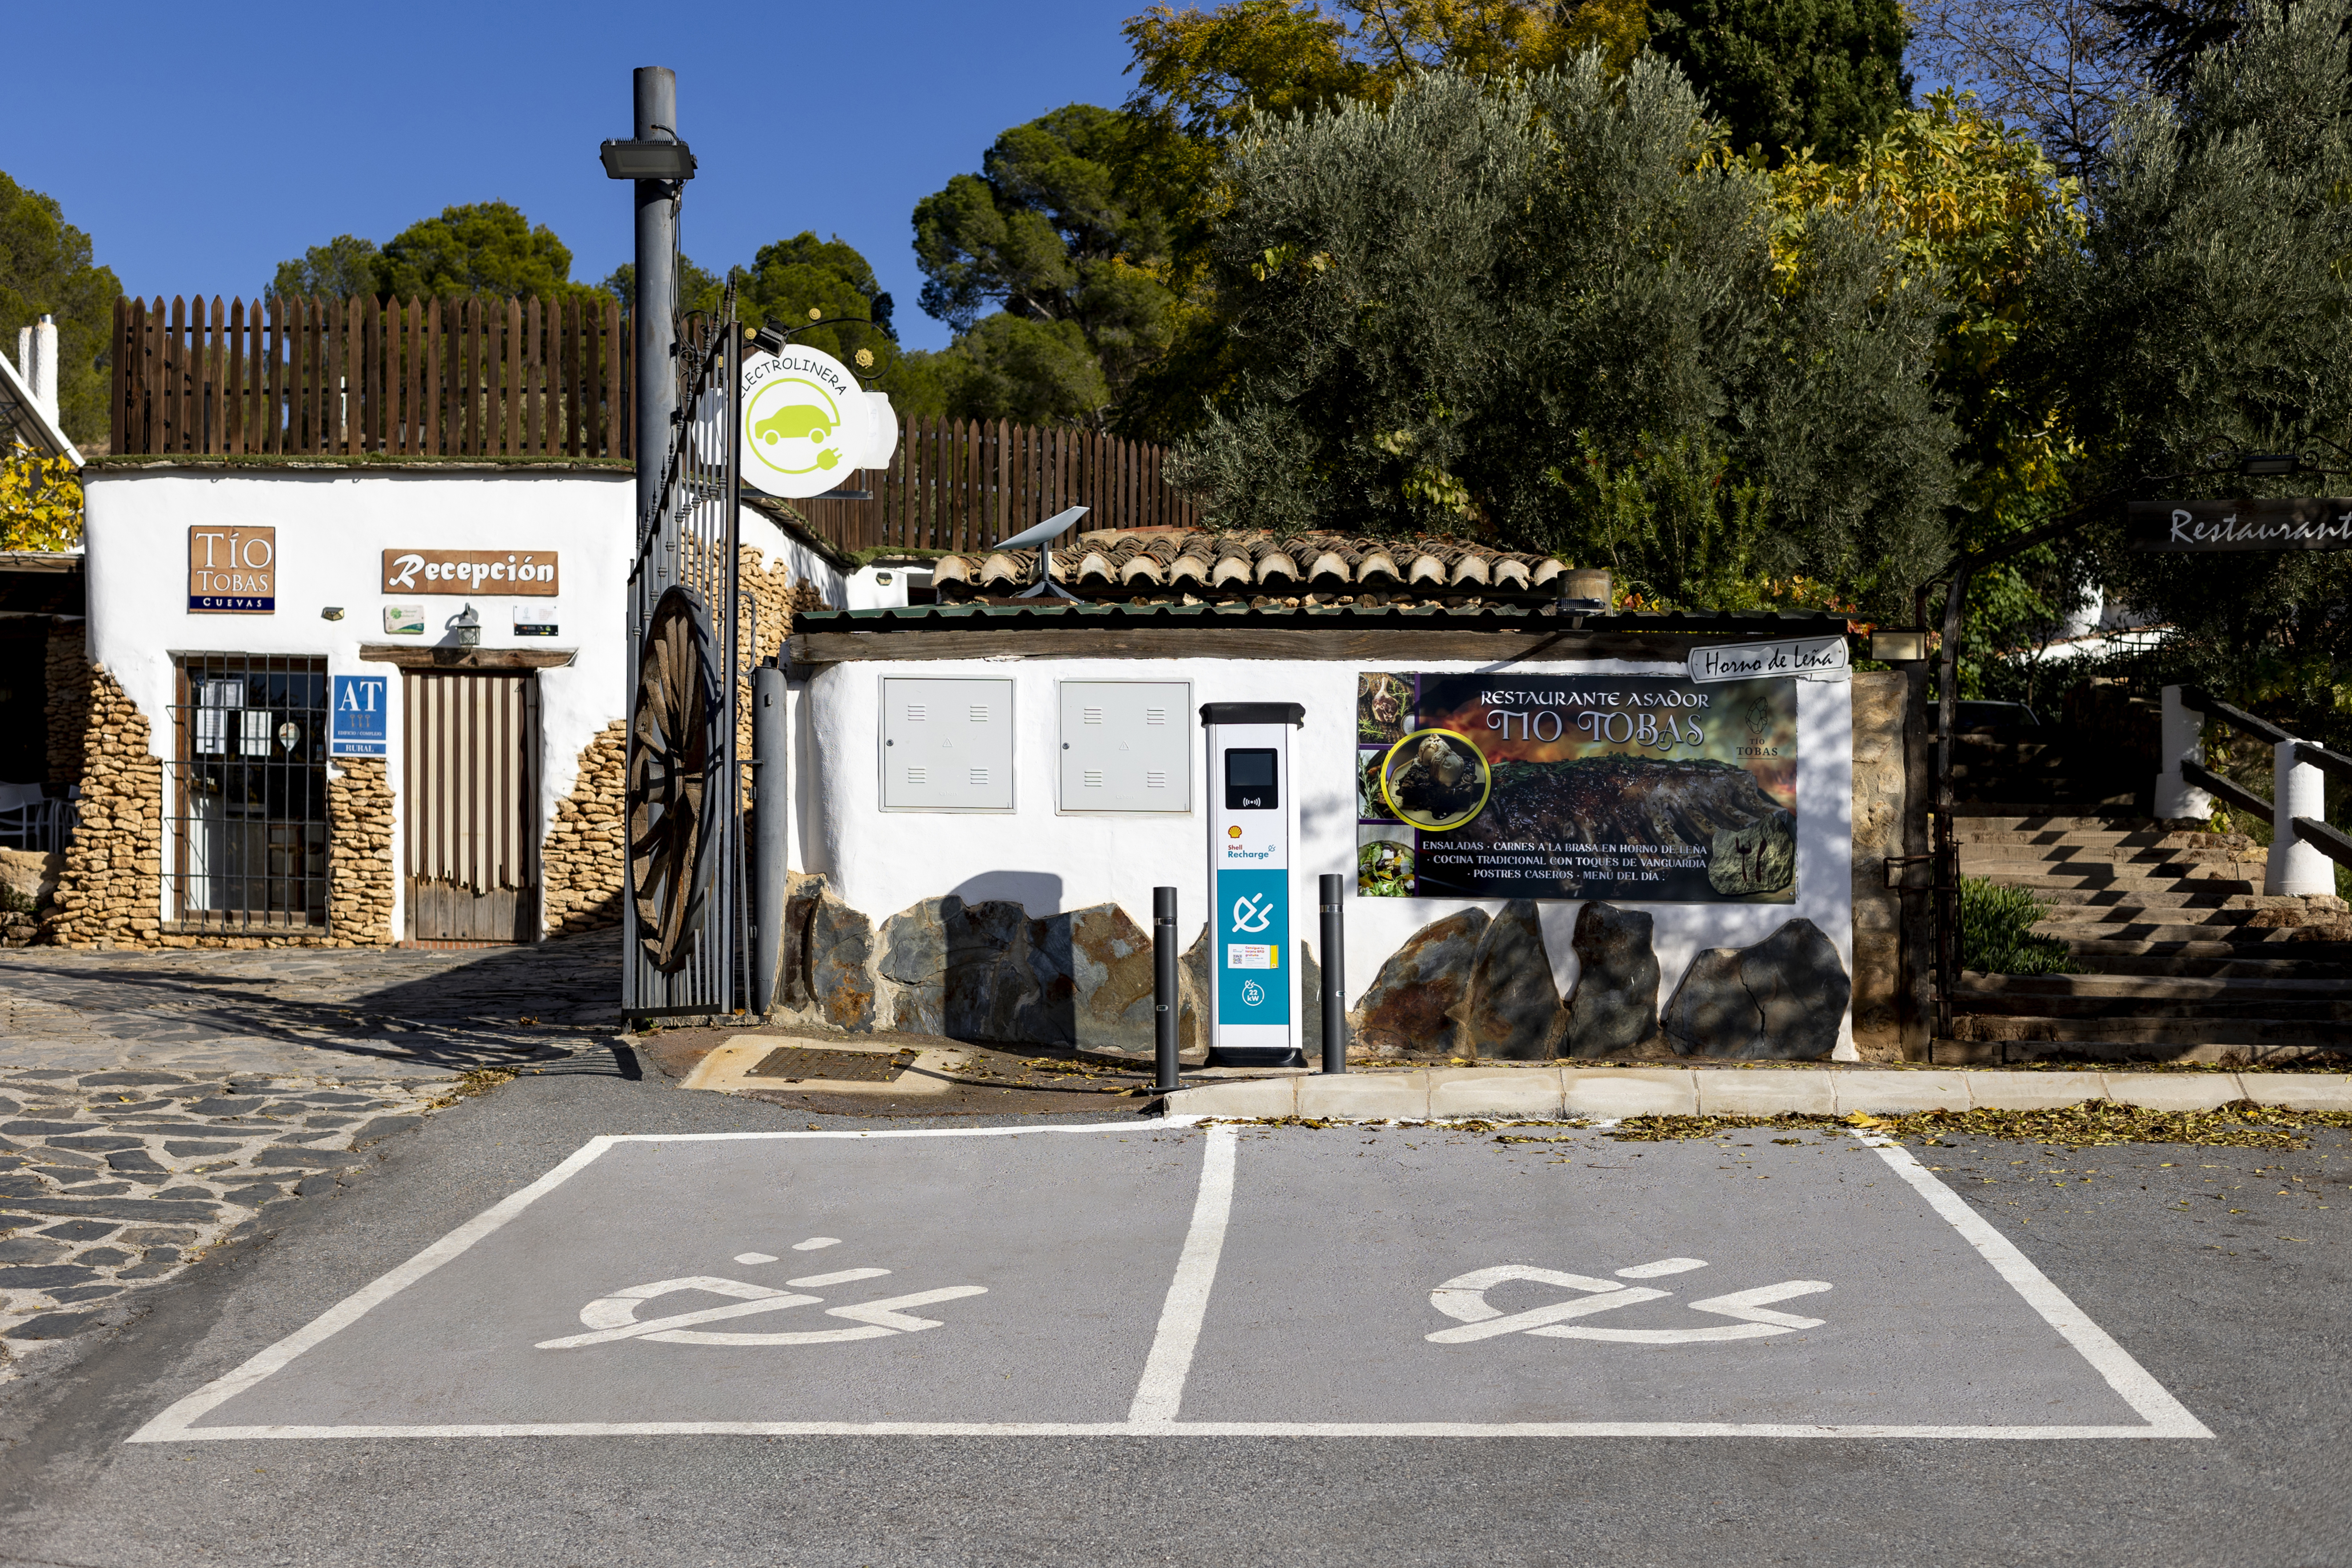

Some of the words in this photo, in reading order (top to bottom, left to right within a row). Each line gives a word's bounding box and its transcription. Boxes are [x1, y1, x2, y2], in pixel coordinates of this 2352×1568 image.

[742, 357, 847, 399] LECTROLINERA
[2170, 509, 2352, 543] Restaurant
[195, 532, 272, 569] TÍO
[388, 553, 554, 590] Recepción
[196, 571, 268, 592] TOBAS
[203, 597, 262, 607] CUEVAS
[1705, 651, 1762, 676] Horno
[1768, 647, 1787, 670] de
[1794, 645, 1833, 668] Leña
[338, 680, 383, 712] AT
[1481, 690, 1621, 707] RESTAURANTE
[1626, 690, 1710, 708] ASADOR
[1486, 709, 1563, 742] TIO
[1577, 710, 1704, 752] TOBAS
[345, 744, 375, 753] RURAL
[1736, 747, 1778, 756] TOBAS
[1228, 850, 1269, 860] Recharge
[1423, 841, 1484, 850] ENSALADAS
[1493, 842, 1535, 851] CARNES
[1537, 842, 1545, 851] A
[1549, 843, 1562, 852] LA
[1565, 843, 1599, 853] BRASA
[1601, 844, 1616, 853] EN
[1620, 844, 1657, 854] HORNO
[1661, 845, 1676, 854] DE
[1680, 844, 1707, 854] LEÑA
[1433, 855, 1473, 864] COCINA
[1476, 855, 1546, 865] TRADICIONAL
[1549, 857, 1572, 866] CON
[1575, 857, 1619, 868] TOQUES
[1623, 858, 1637, 867] DE
[1641, 858, 1706, 868] VANGUARDIA
[1473, 869, 1521, 878] POSTRES
[1525, 870, 1574, 879] CASEROS
[1583, 870, 1613, 880] MENÚ
[1617, 871, 1638, 881] DEL
[1641, 870, 1659, 881] DÍA
